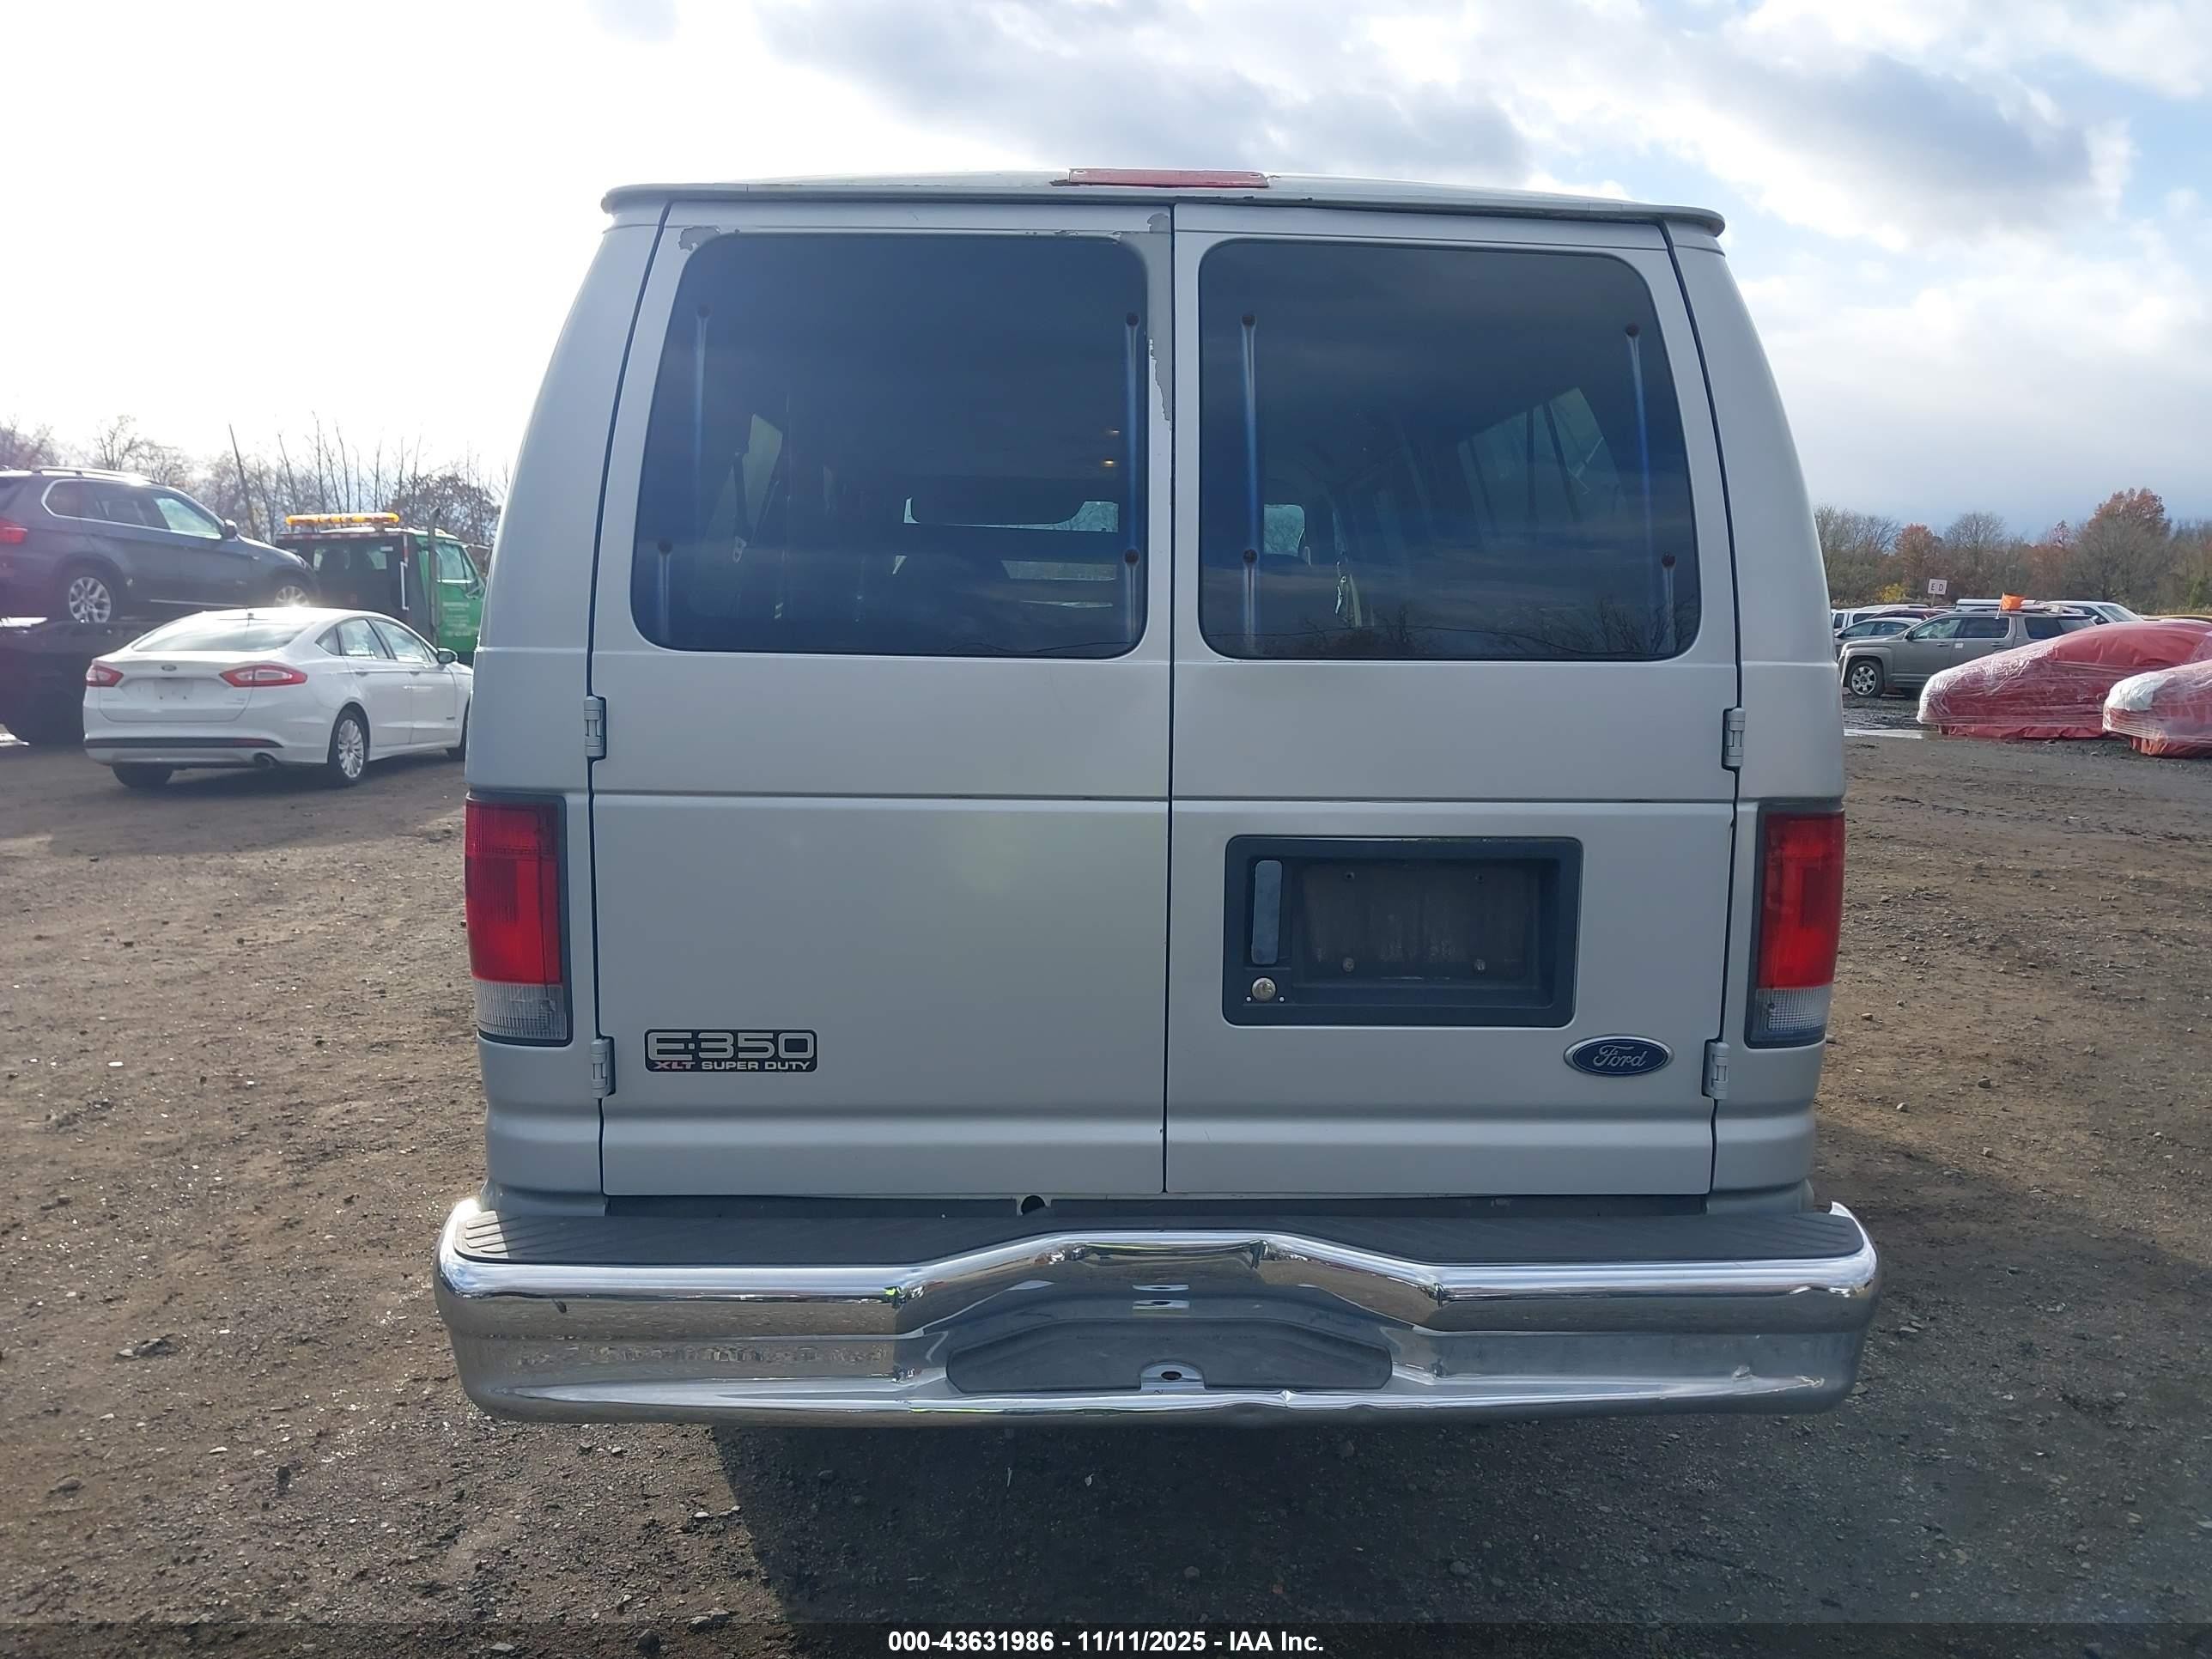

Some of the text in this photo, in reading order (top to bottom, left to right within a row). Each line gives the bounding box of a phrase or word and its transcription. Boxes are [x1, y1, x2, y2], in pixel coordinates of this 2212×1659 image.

[1593, 1044, 1648, 1066] Ford
[653, 1061, 811, 1070] XLT SUPER DUTY
